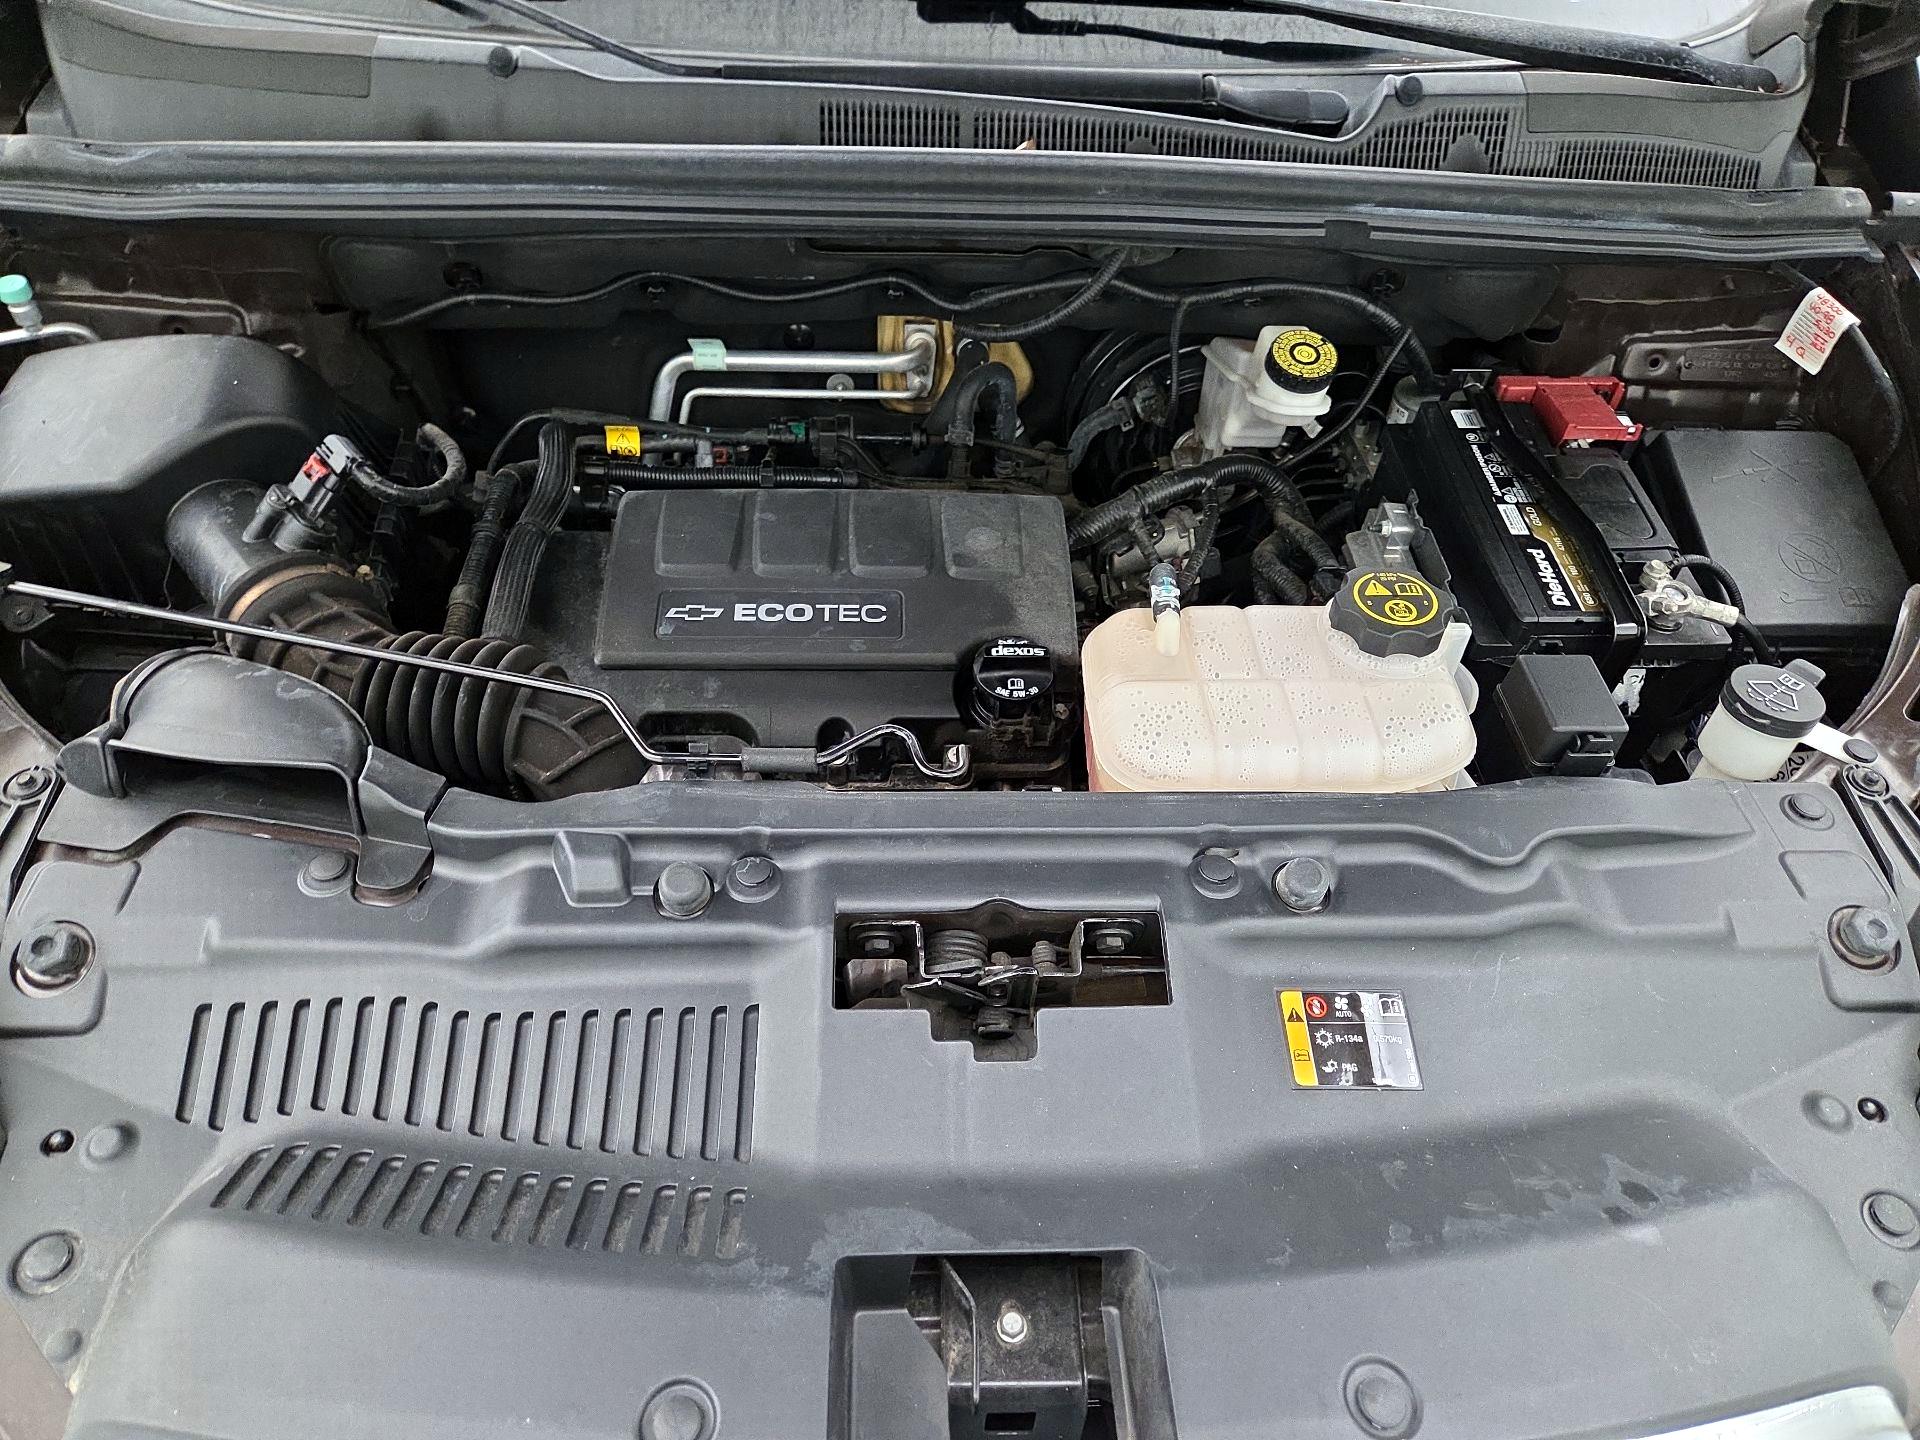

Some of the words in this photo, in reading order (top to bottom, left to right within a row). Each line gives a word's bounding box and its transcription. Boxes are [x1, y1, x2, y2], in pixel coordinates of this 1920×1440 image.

[1525, 506, 1542, 526] GOLD
[1526, 548, 1571, 607] DieHard
[733, 602, 888, 623] ECOTEC
[991, 645, 1046, 656] dexos
[994, 686, 1011, 697] SAE
[1012, 686, 1039, 698] 5W-30
[1335, 1034, 1364, 1043] R-134a
[1341, 1062, 1358, 1072] PAG
